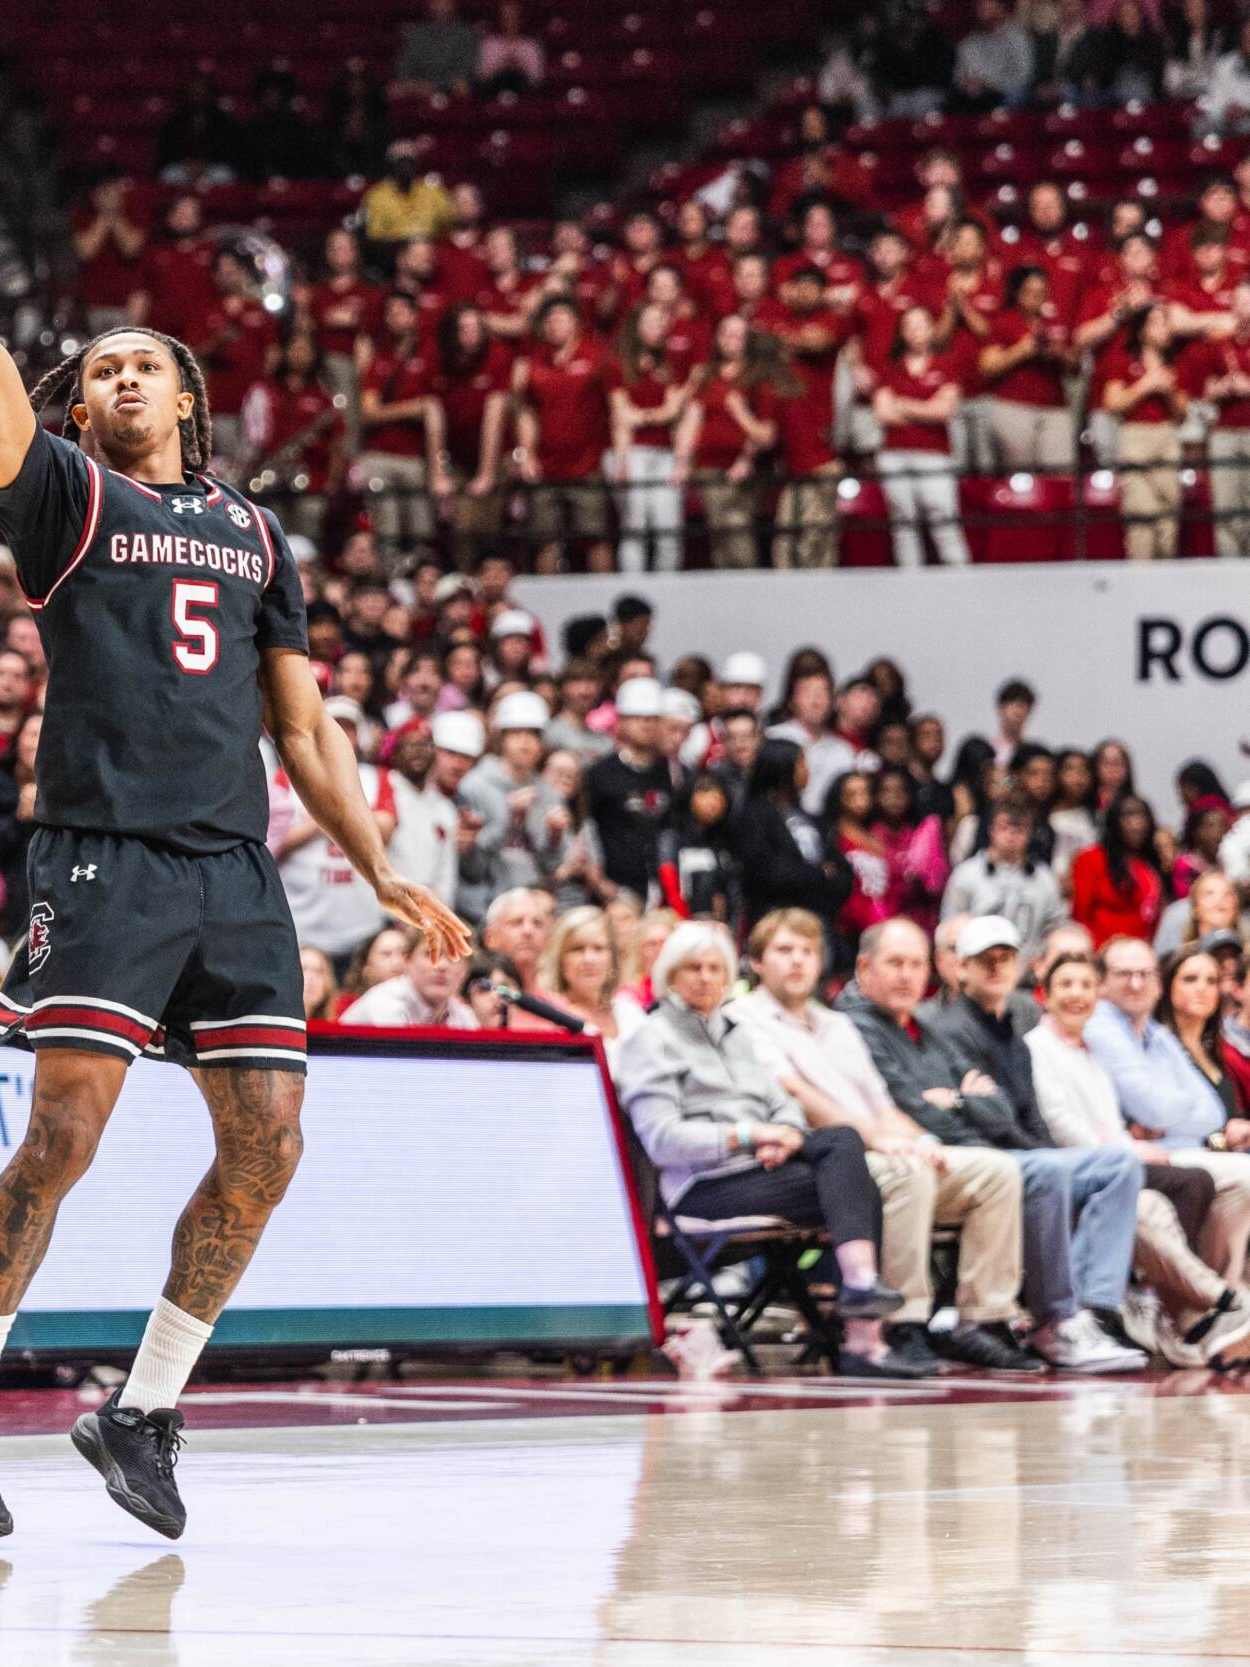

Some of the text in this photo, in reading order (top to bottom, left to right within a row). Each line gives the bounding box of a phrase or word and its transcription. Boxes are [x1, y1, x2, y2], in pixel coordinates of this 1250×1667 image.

[110, 533, 264, 584] GAMECOCKS
[171, 578, 220, 675] 5
[1137, 617, 1250, 683] RO
